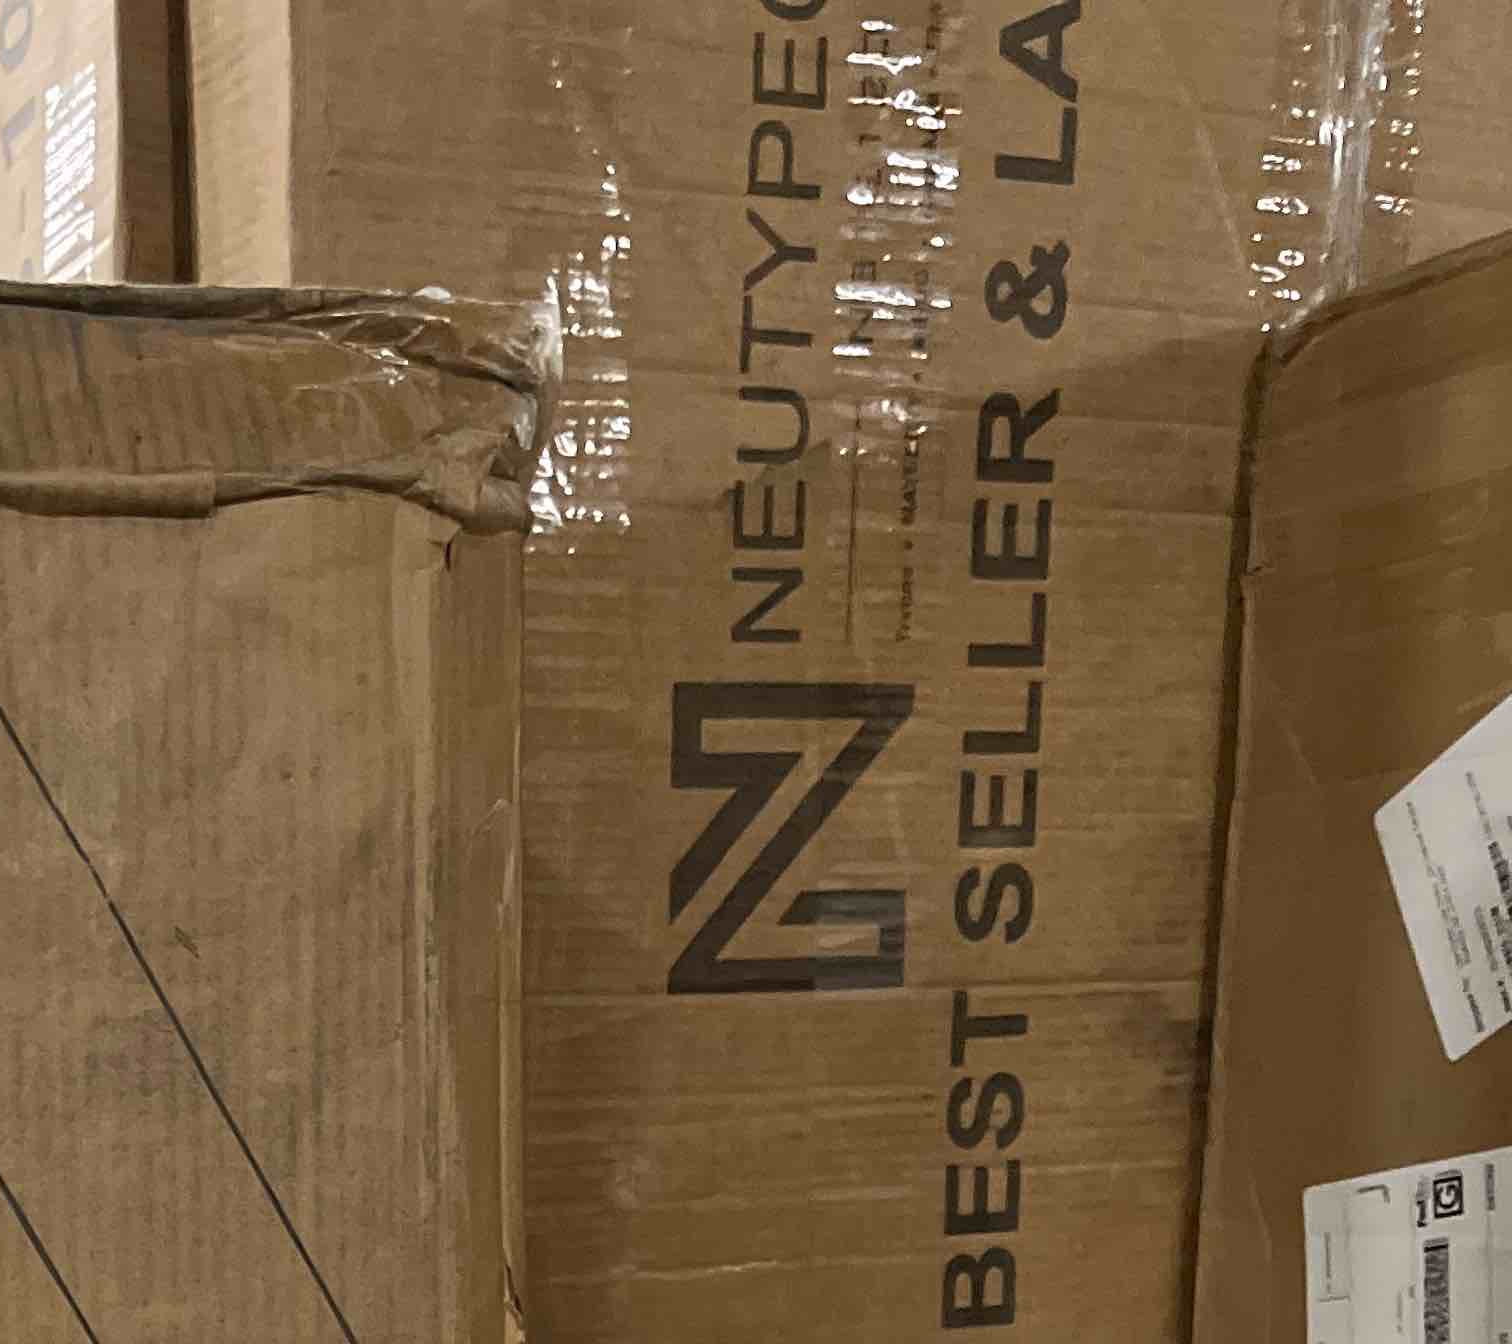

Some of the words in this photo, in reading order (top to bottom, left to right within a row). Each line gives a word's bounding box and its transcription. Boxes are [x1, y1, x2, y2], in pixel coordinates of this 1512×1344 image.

[985, 240, 1071, 340] &
[953, 387, 1064, 944] SELLER
[941, 989, 1026, 1329] BEST
